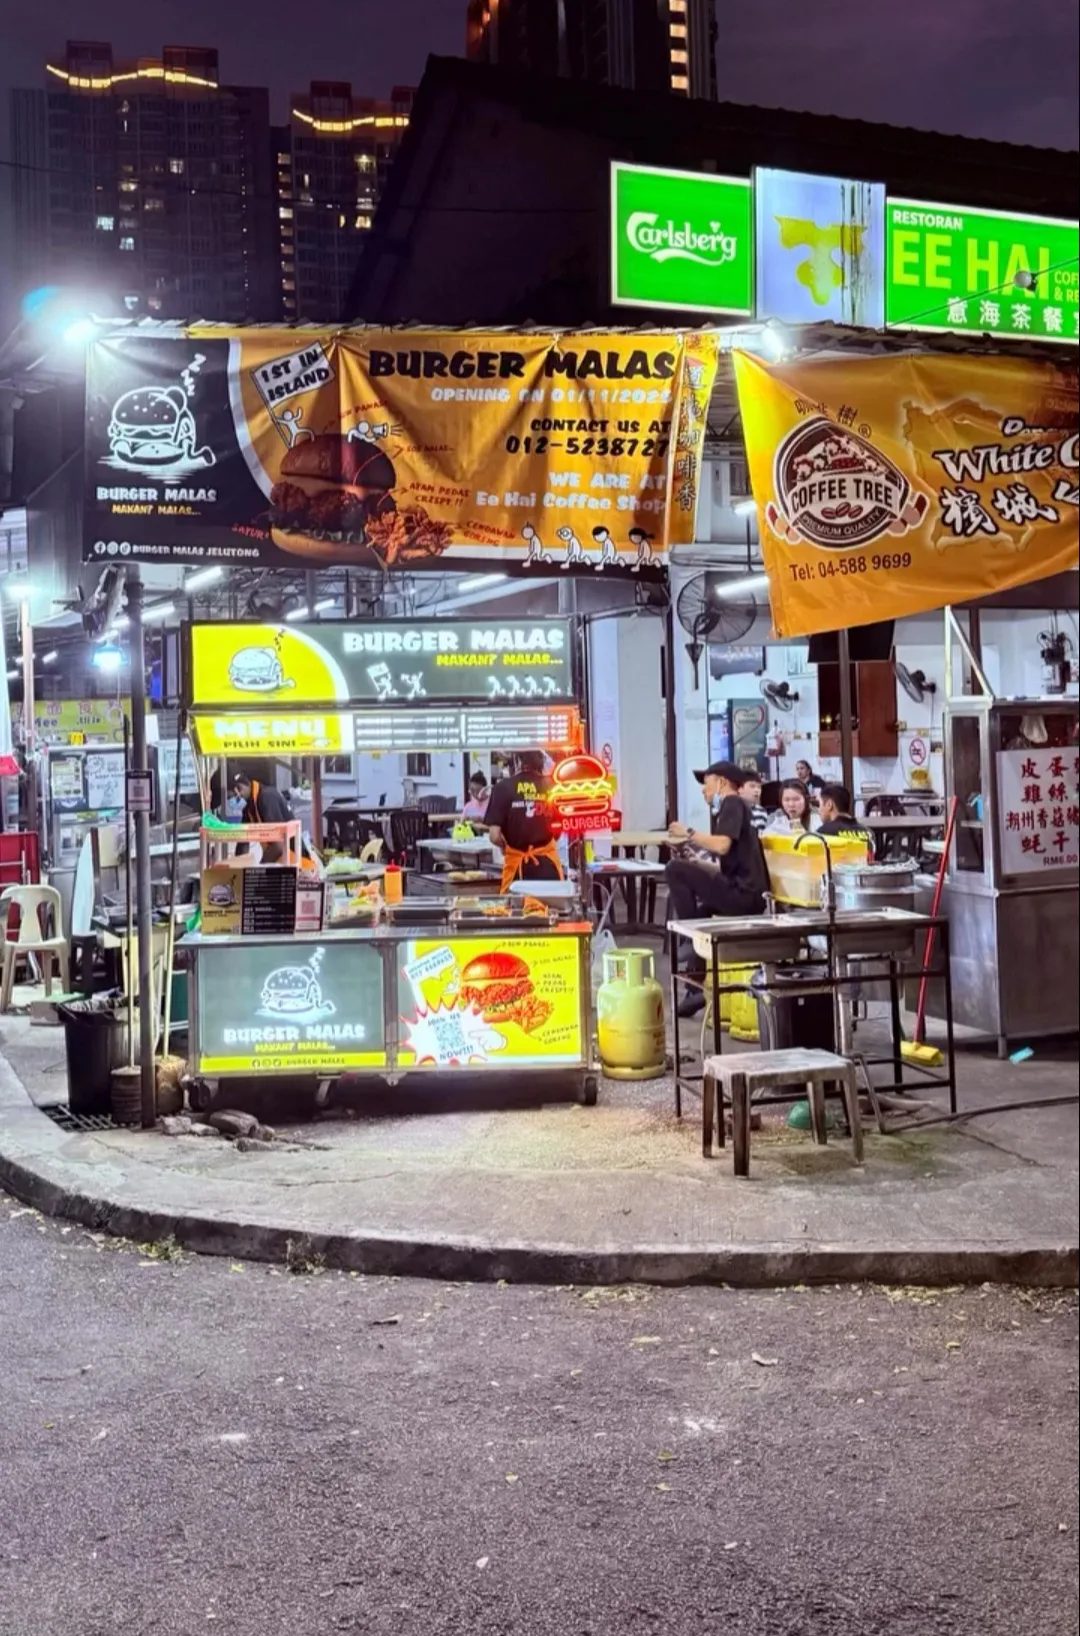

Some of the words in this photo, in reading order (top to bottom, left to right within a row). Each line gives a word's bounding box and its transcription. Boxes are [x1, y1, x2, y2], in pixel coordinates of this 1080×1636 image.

[893, 209, 963, 231] RESTORAN
[626, 211, 737, 261] Carlsberg
[892, 229, 952, 290] EE
[966, 238, 1050, 301] HAI
[298, 348, 319, 368] IN
[368, 350, 525, 379] BURGER
[544, 350, 675, 379] MALAS
[267, 368, 329, 401] ISLAND
[431, 387, 510, 402] OPENING
[519, 387, 543, 402] ON
[531, 419, 609, 433] CONTACT
[618, 419, 640, 433] US
[648, 419, 671, 433] AT
[505, 436, 670, 457] 012-5238727
[934, 445, 1052, 482] White
[409, 482, 435, 494] AYAM
[438, 484, 471, 497] PEDAS
[548, 472, 581, 488] WE
[590, 473, 630, 489] ARE
[639, 474, 666, 490] AT
[96, 486, 158, 501] BURGER
[165, 487, 217, 502] MALAS
[414, 494, 452, 506] CRISPY
[476, 491, 499, 507] Ee
[504, 492, 537, 507] Hai
[542, 493, 611, 509] Coffee
[616, 495, 666, 513] Shop
[791, 479, 847, 513] COFFEE
[854, 479, 893, 507] TREE
[466, 520, 516, 540] CENDAWAN
[801, 514, 842, 535] PREMIUM
[843, 509, 881, 535] QUALITY
[132, 544, 171, 555] BURGER
[173, 545, 204, 556] MALAS
[206, 546, 260, 558] JELUTONG
[789, 562, 815, 582] Tel:
[818, 558, 867, 578] 04-588
[872, 552, 912, 570] 9699
[342, 631, 459, 653] BURGER
[470, 629, 565, 651] MALAS
[213, 718, 325, 739] MENU
[517, 782, 537, 794] APA
[1021, 782, 1078, 805] 雞絲
[562, 816, 610, 831] BURGER
[223, 1025, 300, 1043] BURGER
[306, 1023, 365, 1041] MALAS
